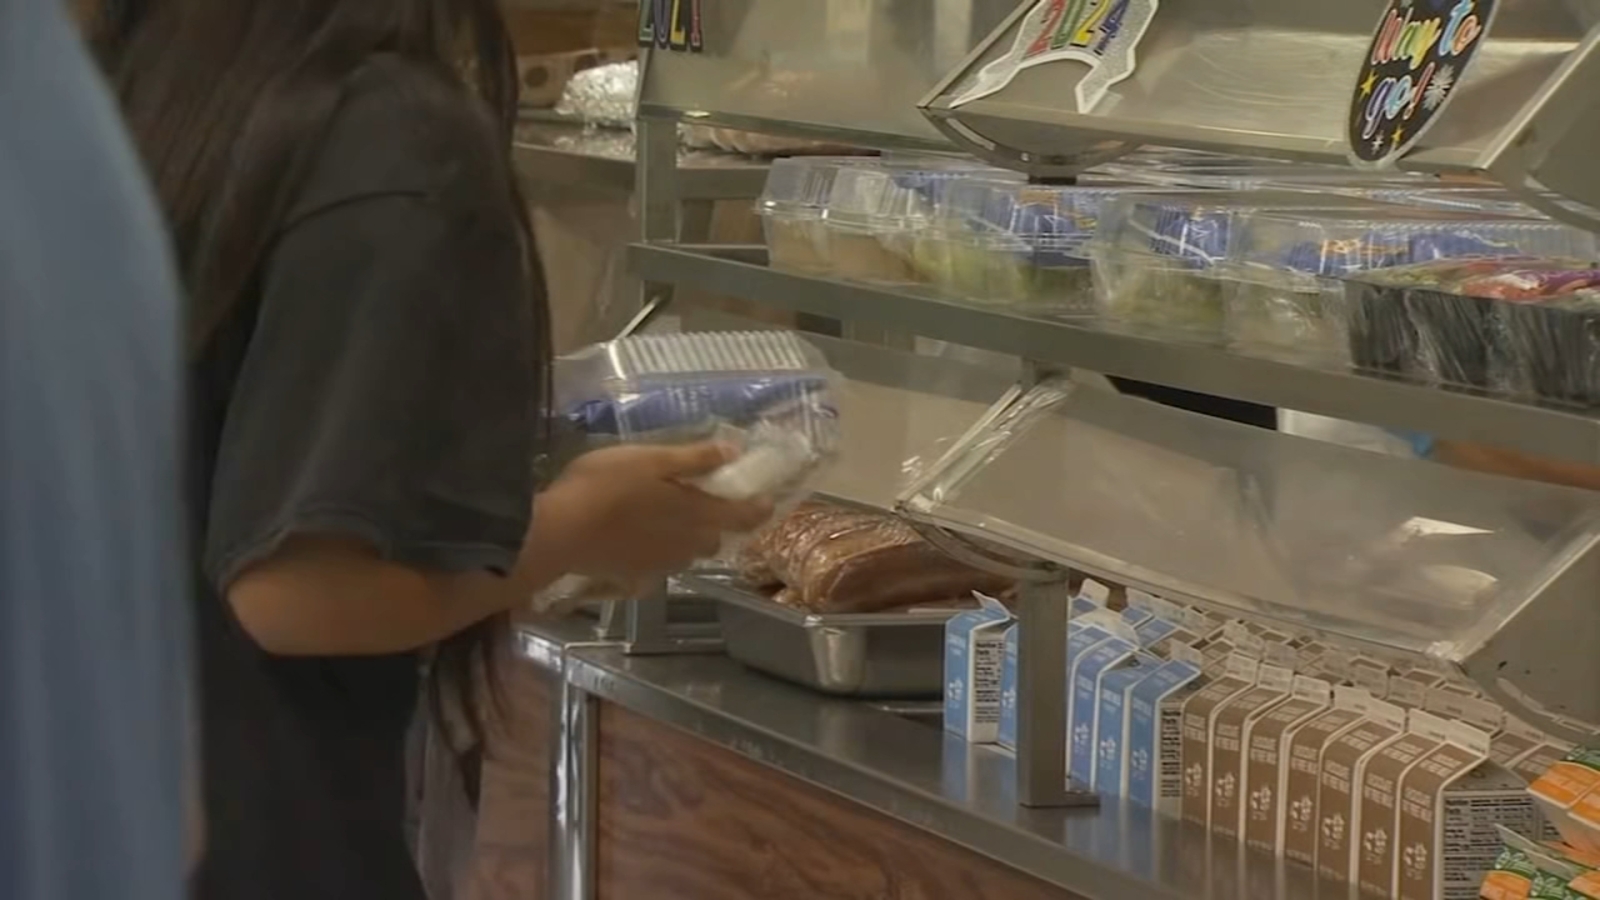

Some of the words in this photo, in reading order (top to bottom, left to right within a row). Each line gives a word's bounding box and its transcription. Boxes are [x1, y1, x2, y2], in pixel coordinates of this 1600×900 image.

[1370, 7, 1442, 70] Way
[1438, 0, 1482, 56] to
[1362, 61, 1436, 139] go!
